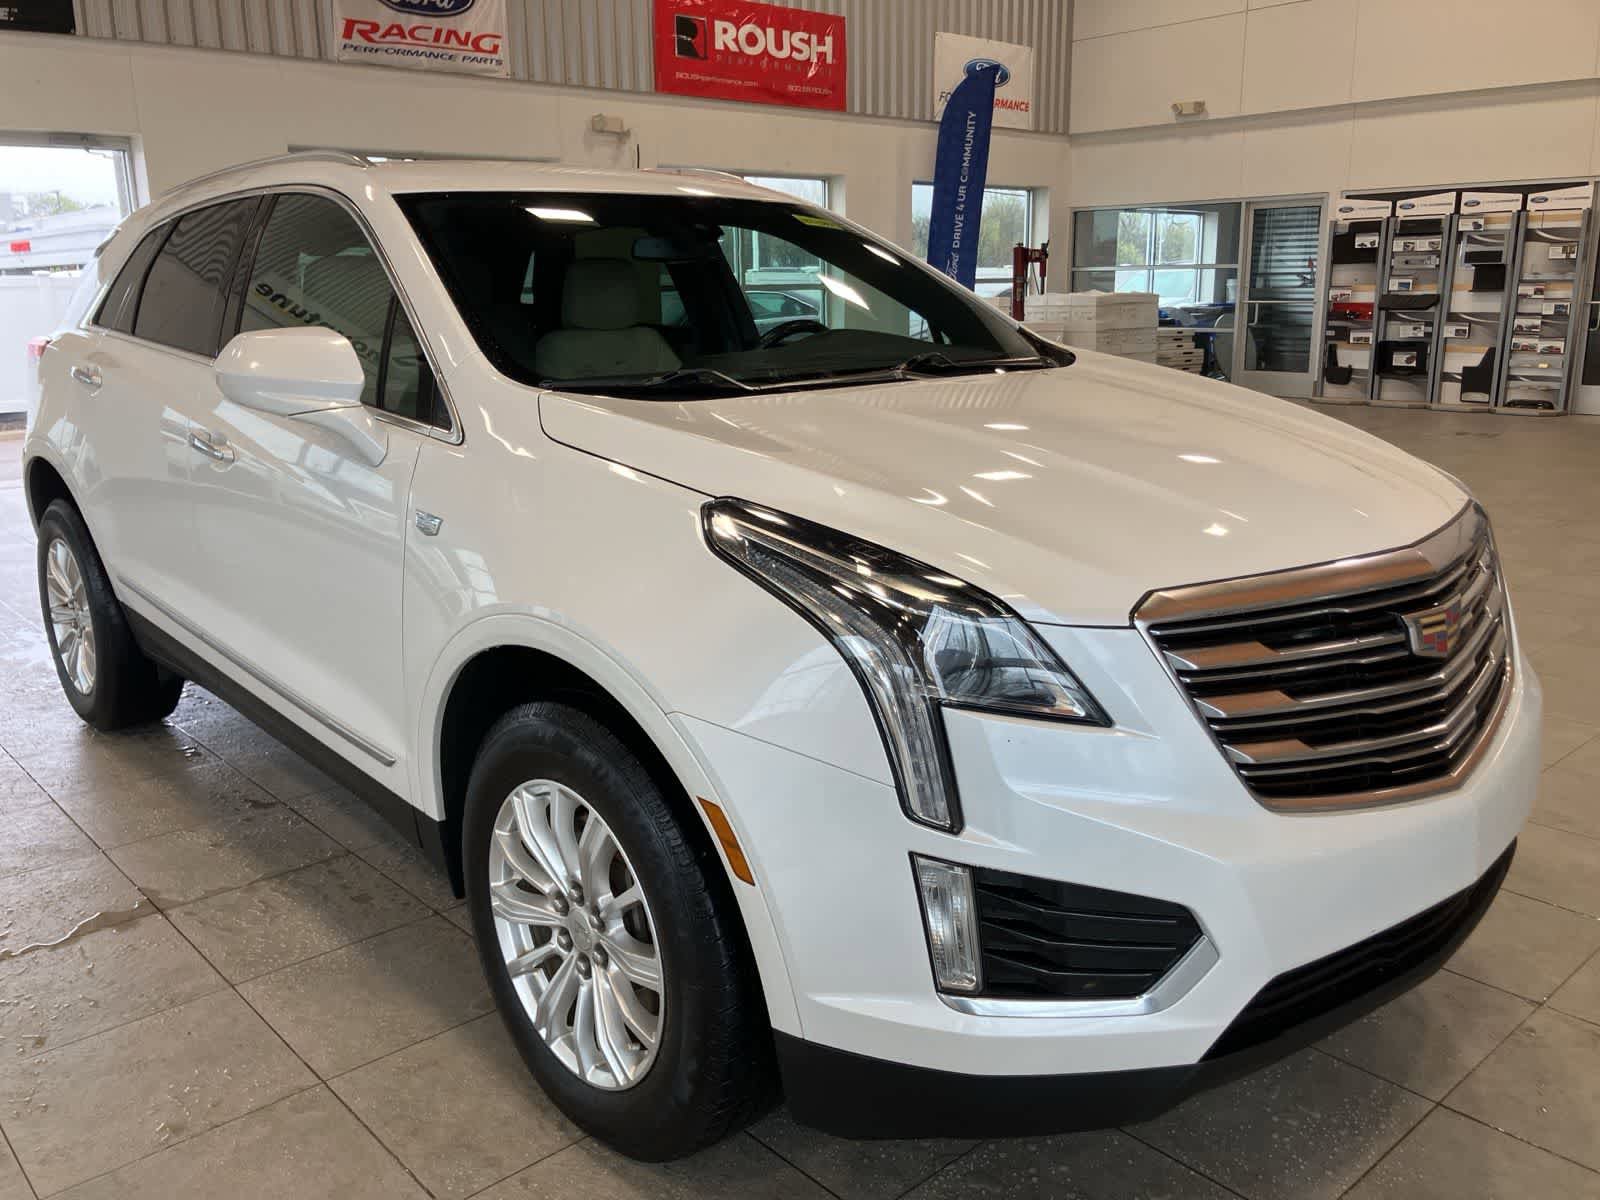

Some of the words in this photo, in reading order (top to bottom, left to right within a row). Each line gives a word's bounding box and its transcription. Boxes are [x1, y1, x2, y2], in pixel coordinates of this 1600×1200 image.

[342, 18, 502, 55] RACING
[342, 43, 458, 62] PERFORMANCE
[462, 55, 504, 66] PARTS
[713, 19, 833, 65] ROUSH
[993, 98, 1030, 113] RMANCE
[960, 111, 977, 183] COMMUNITY
[957, 185, 968, 201] UR
[952, 213, 965, 249] DRIVE
